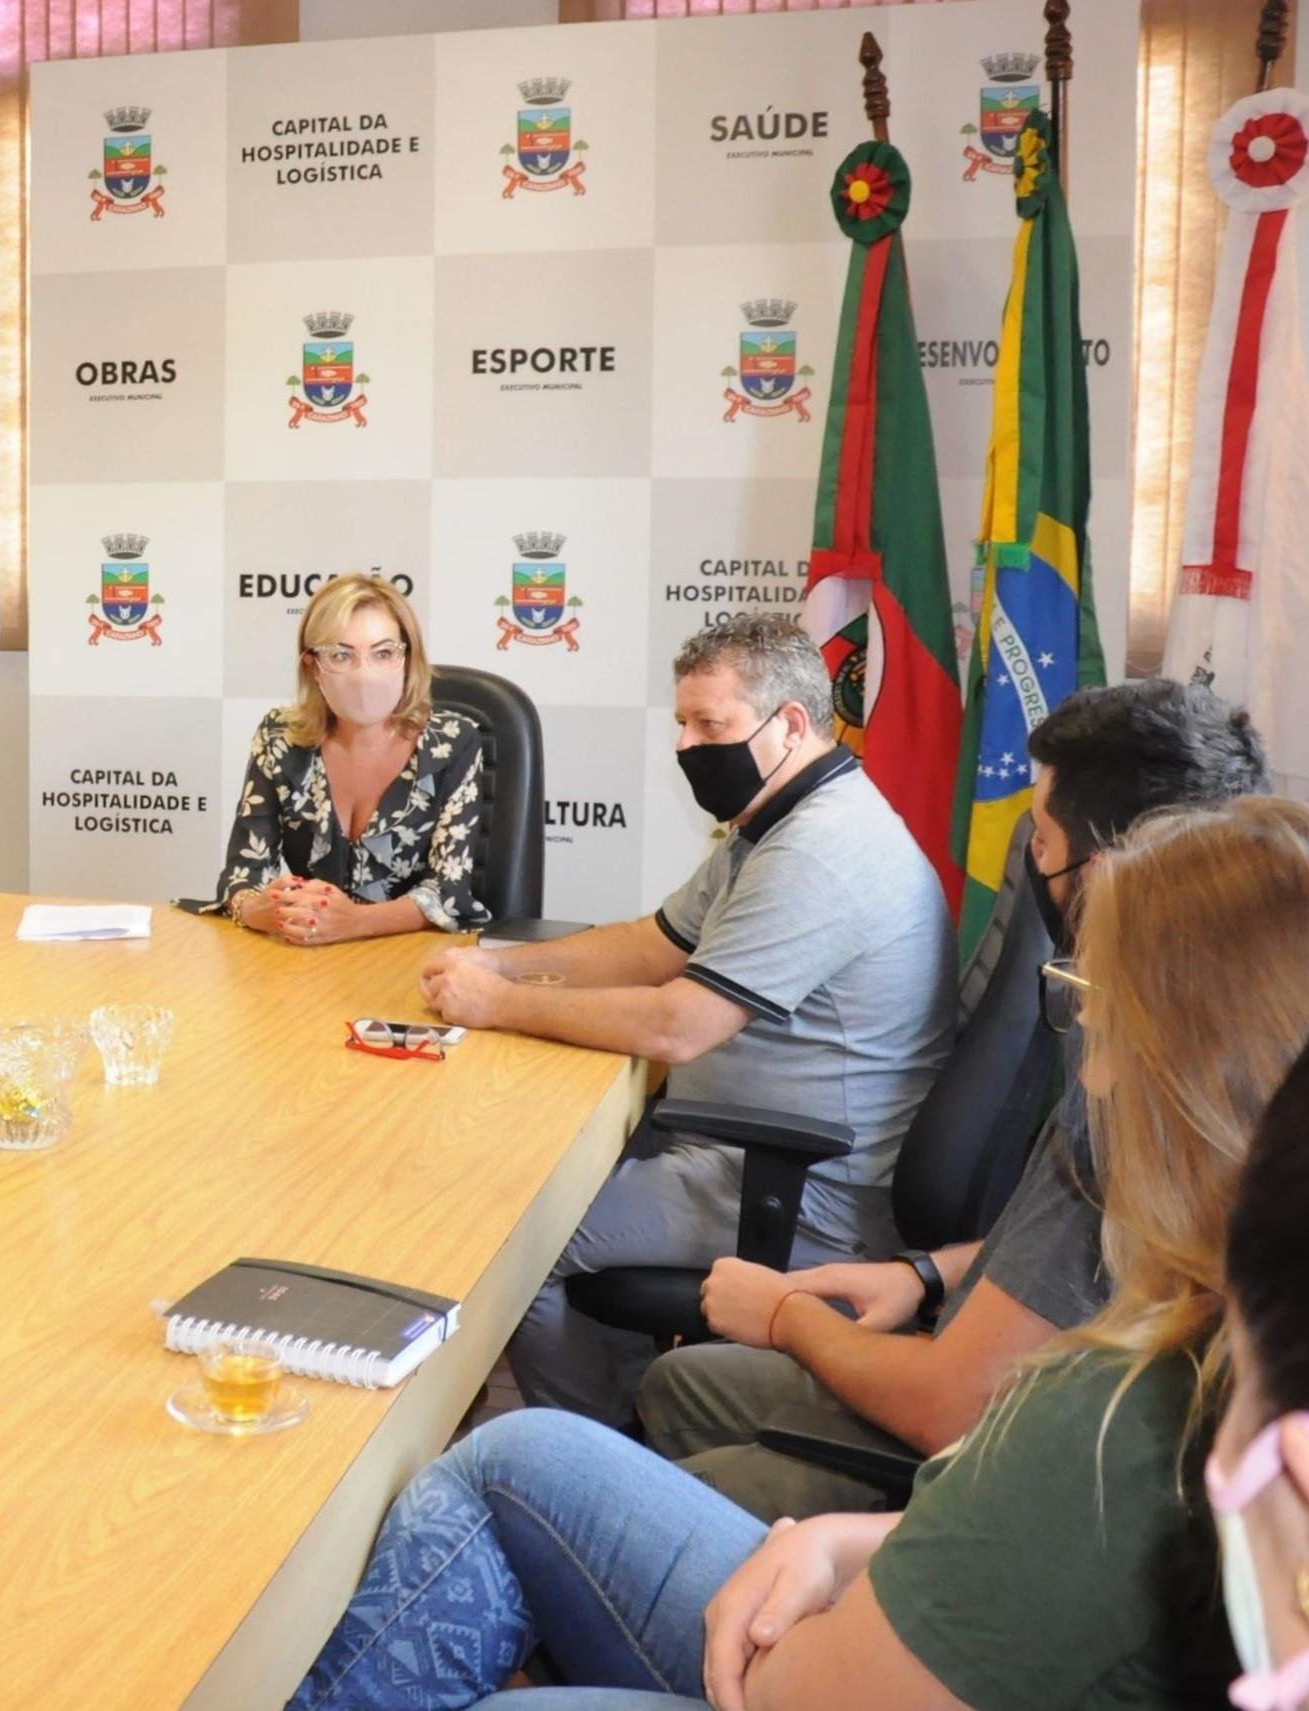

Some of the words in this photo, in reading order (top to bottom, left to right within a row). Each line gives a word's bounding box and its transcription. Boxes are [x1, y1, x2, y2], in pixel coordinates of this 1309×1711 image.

[272, 116, 352, 136] CAPITAL
[359, 114, 388, 130] DA
[710, 104, 828, 141] SAÚDE
[242, 138, 401, 162] HOSPITALIDADE
[409, 136, 419, 152] E
[276, 162, 382, 185] LOGÍSTICA
[472, 347, 615, 374] ESPORTE
[76, 359, 176, 386] OBRAS
[700, 559, 788, 577] CAPITAL
[71, 769, 145, 786] CAPITAL
[152, 771, 178, 787] DA
[42, 792, 190, 811] HOSPITALIDADE
[198, 797, 207, 812] E
[75, 812, 173, 834] LOGÍSTICA
[545, 801, 626, 828] LTURA
